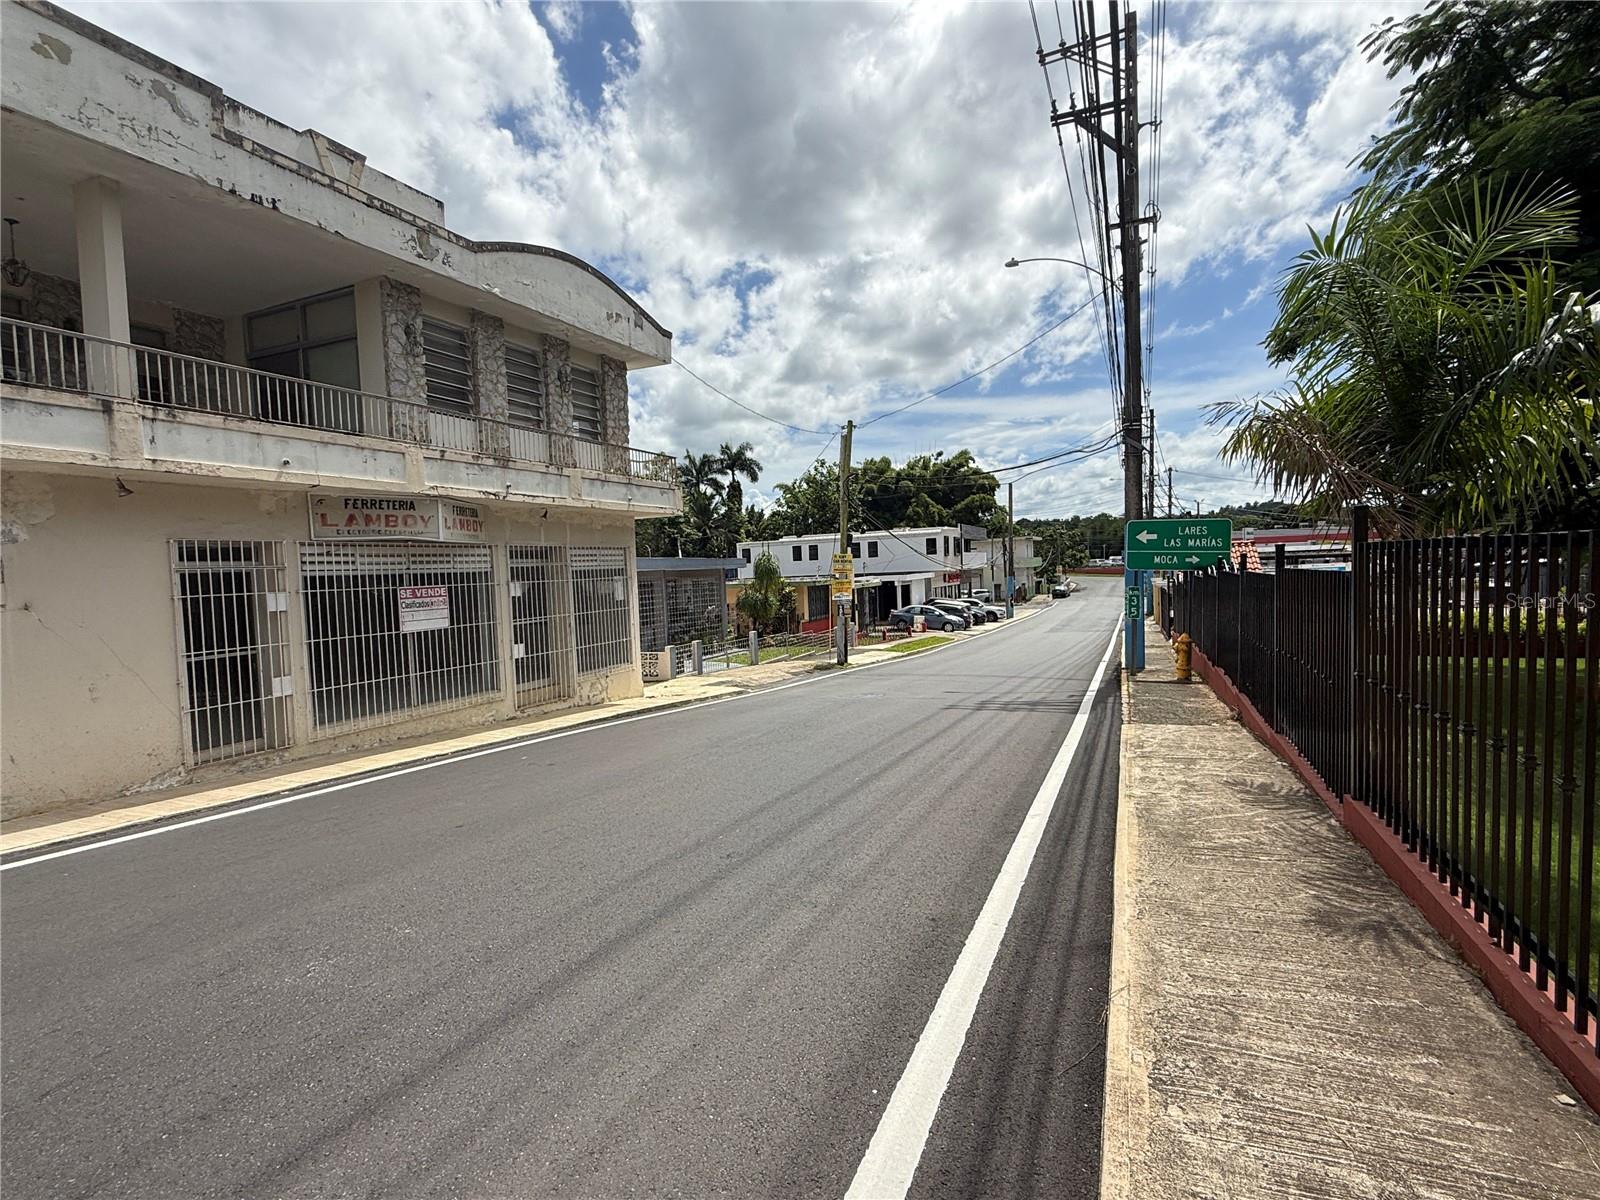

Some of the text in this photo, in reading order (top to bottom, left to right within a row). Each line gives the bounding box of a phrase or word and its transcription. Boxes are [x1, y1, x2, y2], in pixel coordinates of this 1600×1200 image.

[344, 498, 416, 511] FERRETERIA
[452, 505, 478, 518] FERRETERIA
[444, 517, 483, 533] LAMBOY
[1178, 526, 1208, 535] LARES
[1164, 536, 1223, 547] LAS MARÍAS
[1154, 555, 1178, 564] MOCA
[400, 587, 447, 599] SE VENDE
